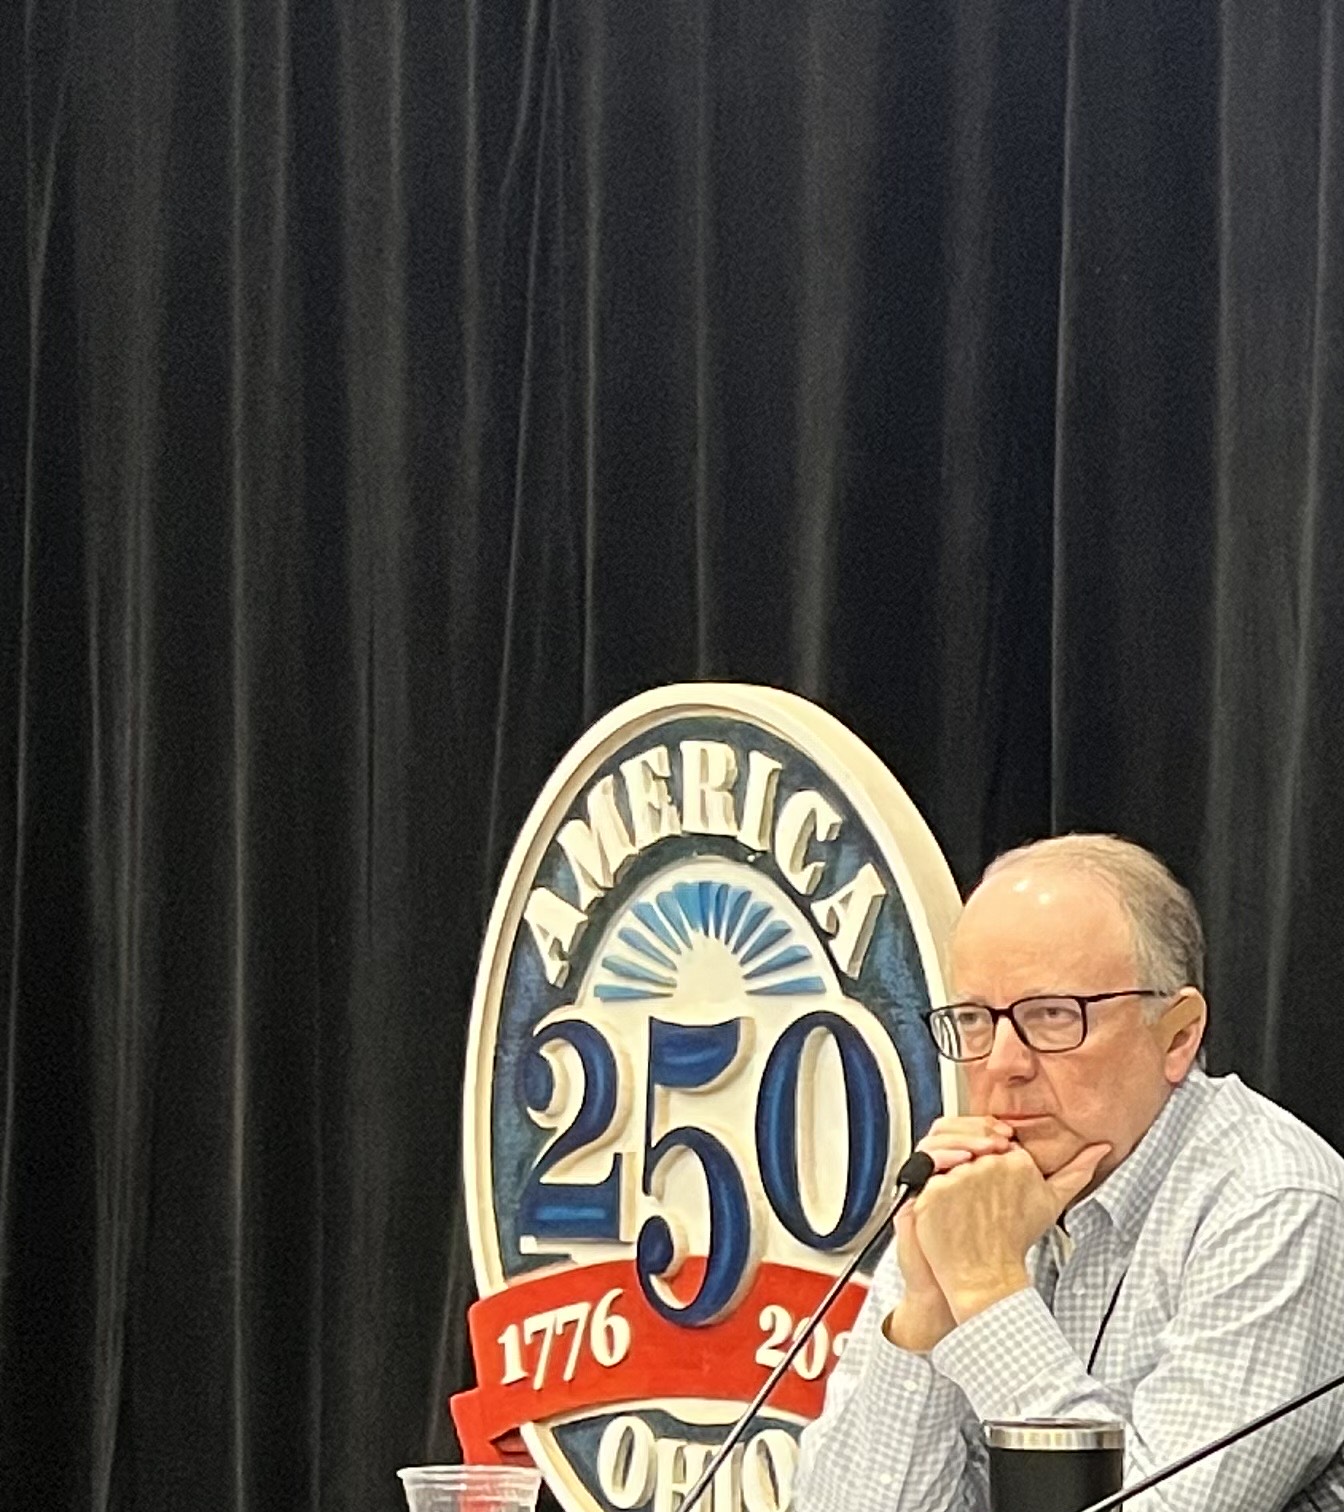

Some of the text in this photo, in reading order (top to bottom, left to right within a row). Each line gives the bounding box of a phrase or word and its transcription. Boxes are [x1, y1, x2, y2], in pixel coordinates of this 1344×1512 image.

[524, 740, 886, 988] AMERICA
[517, 1010, 891, 1328] 250
[497, 1288, 631, 1390] 1776
